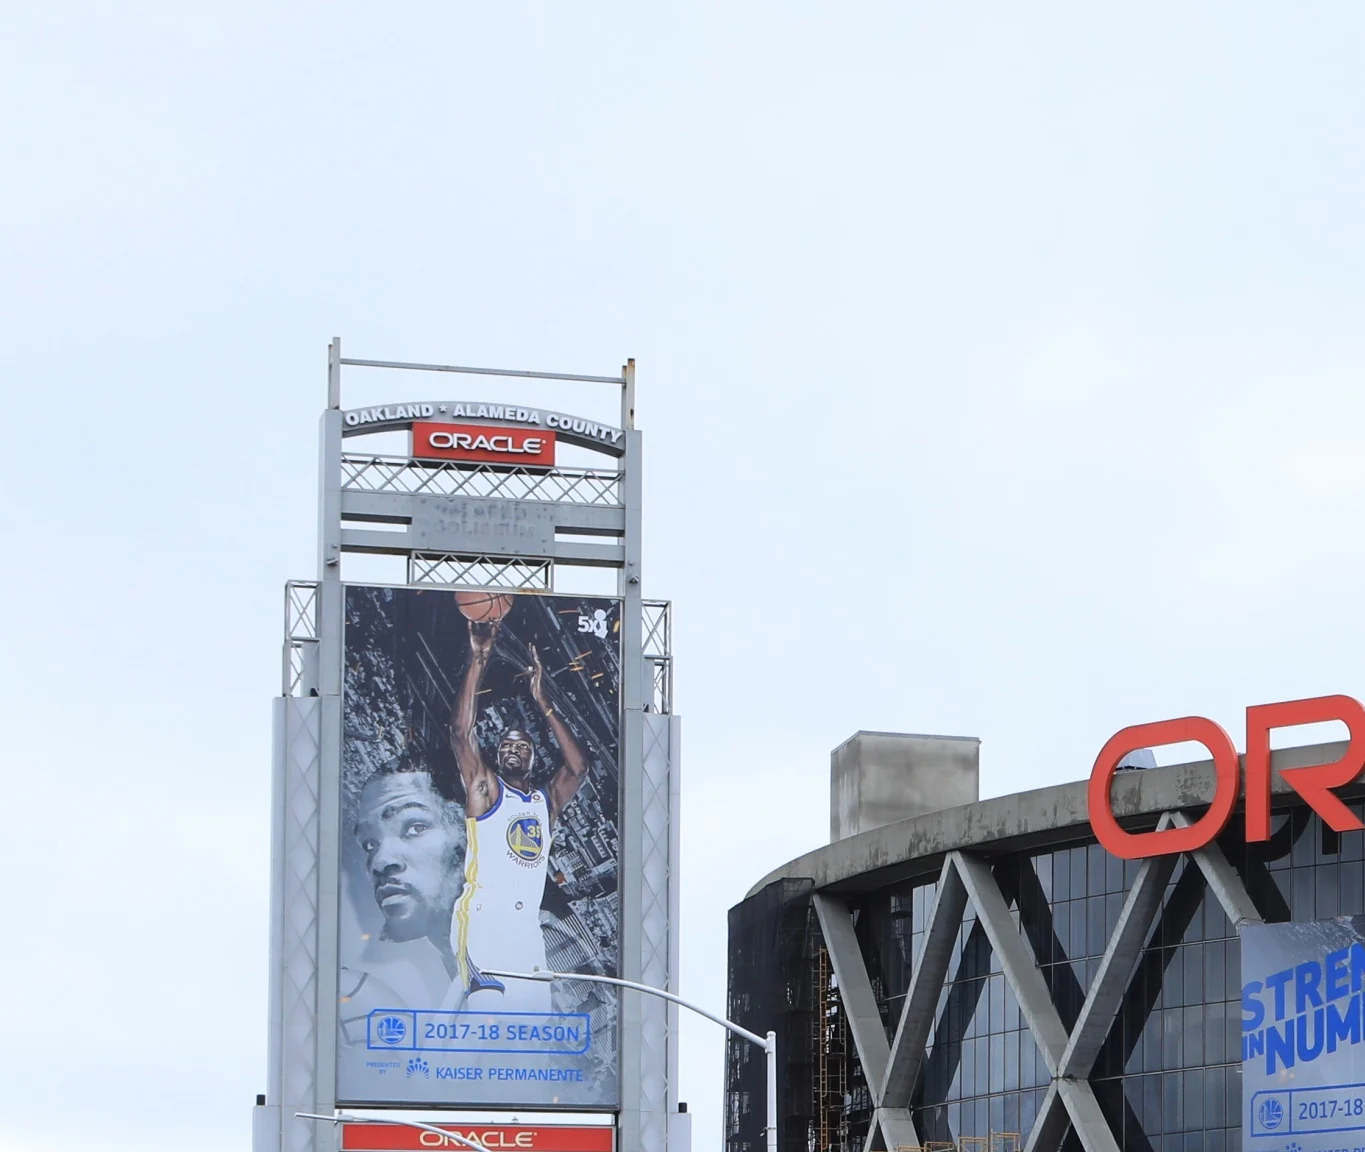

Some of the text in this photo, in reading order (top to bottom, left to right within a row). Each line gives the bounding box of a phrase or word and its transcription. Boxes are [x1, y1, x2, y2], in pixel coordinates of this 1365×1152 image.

[345, 403, 624, 444] OAKLAND ALAMEDA COUNTY
[428, 431, 544, 454] ORACLE
[424, 1022, 580, 1042] 2017-18 SEASON
[1242, 1029, 1264, 1062] IN
[435, 1066, 584, 1082] KAISER PERMANENTE
[1298, 1097, 1364, 1121] 2017-18
[419, 1130, 534, 1148] ORACLE
